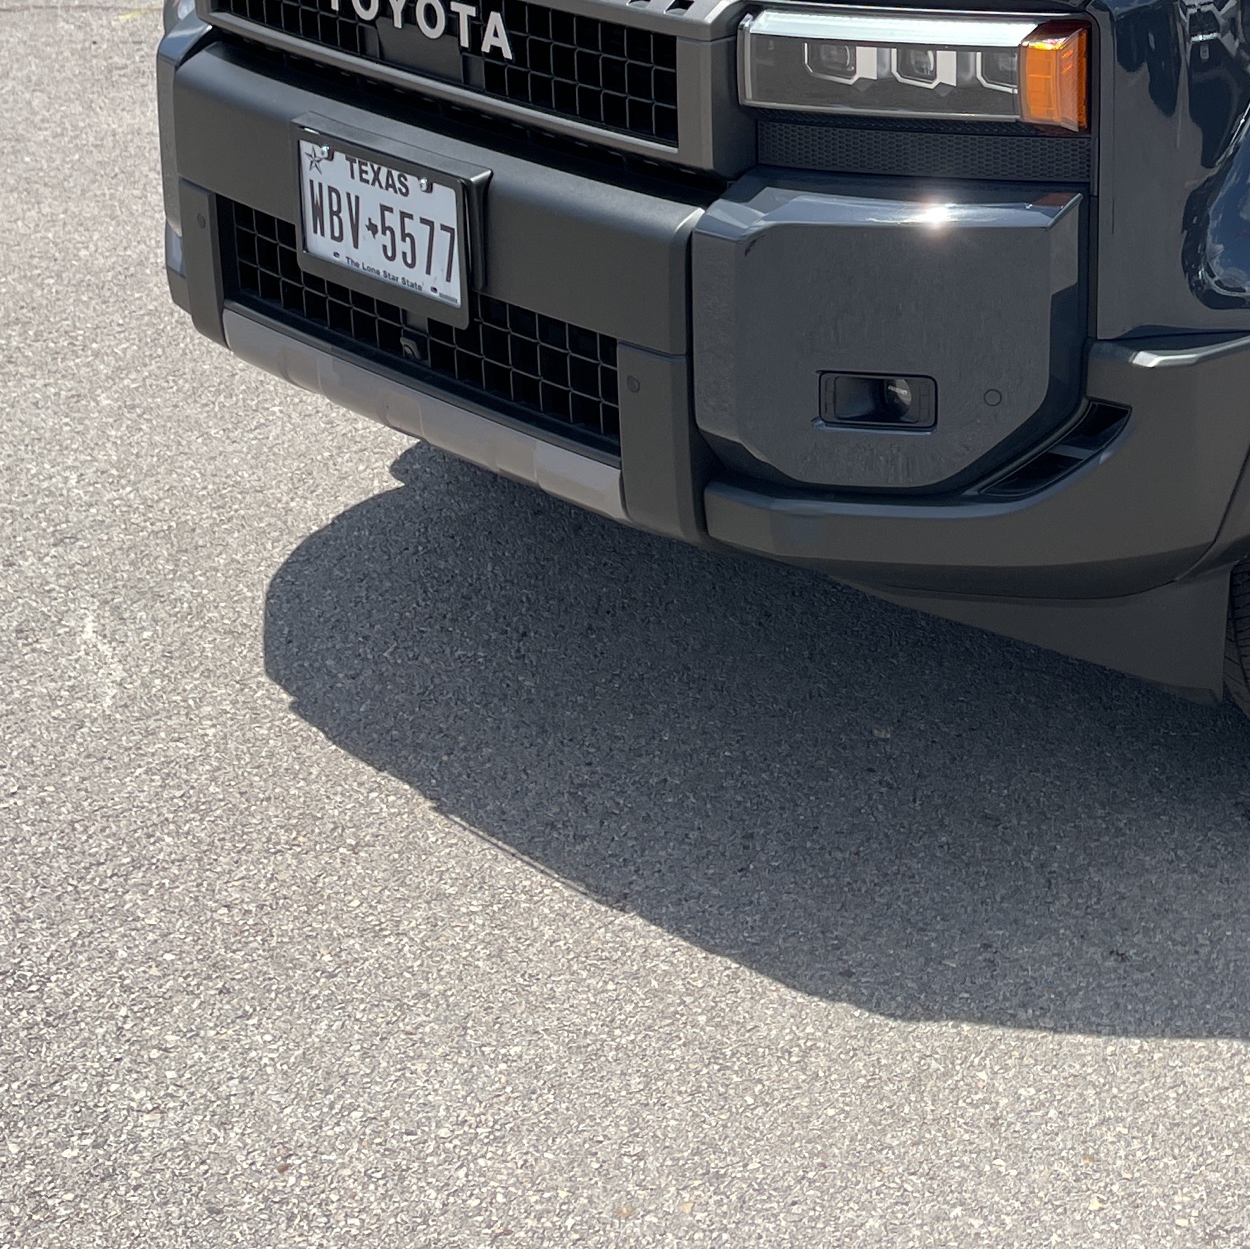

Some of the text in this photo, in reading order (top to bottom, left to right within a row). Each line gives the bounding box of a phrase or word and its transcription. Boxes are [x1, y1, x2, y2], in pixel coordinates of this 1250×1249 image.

[345, 155, 410, 197] TEXAS
[345, 256, 423, 291] The Lone Star State
